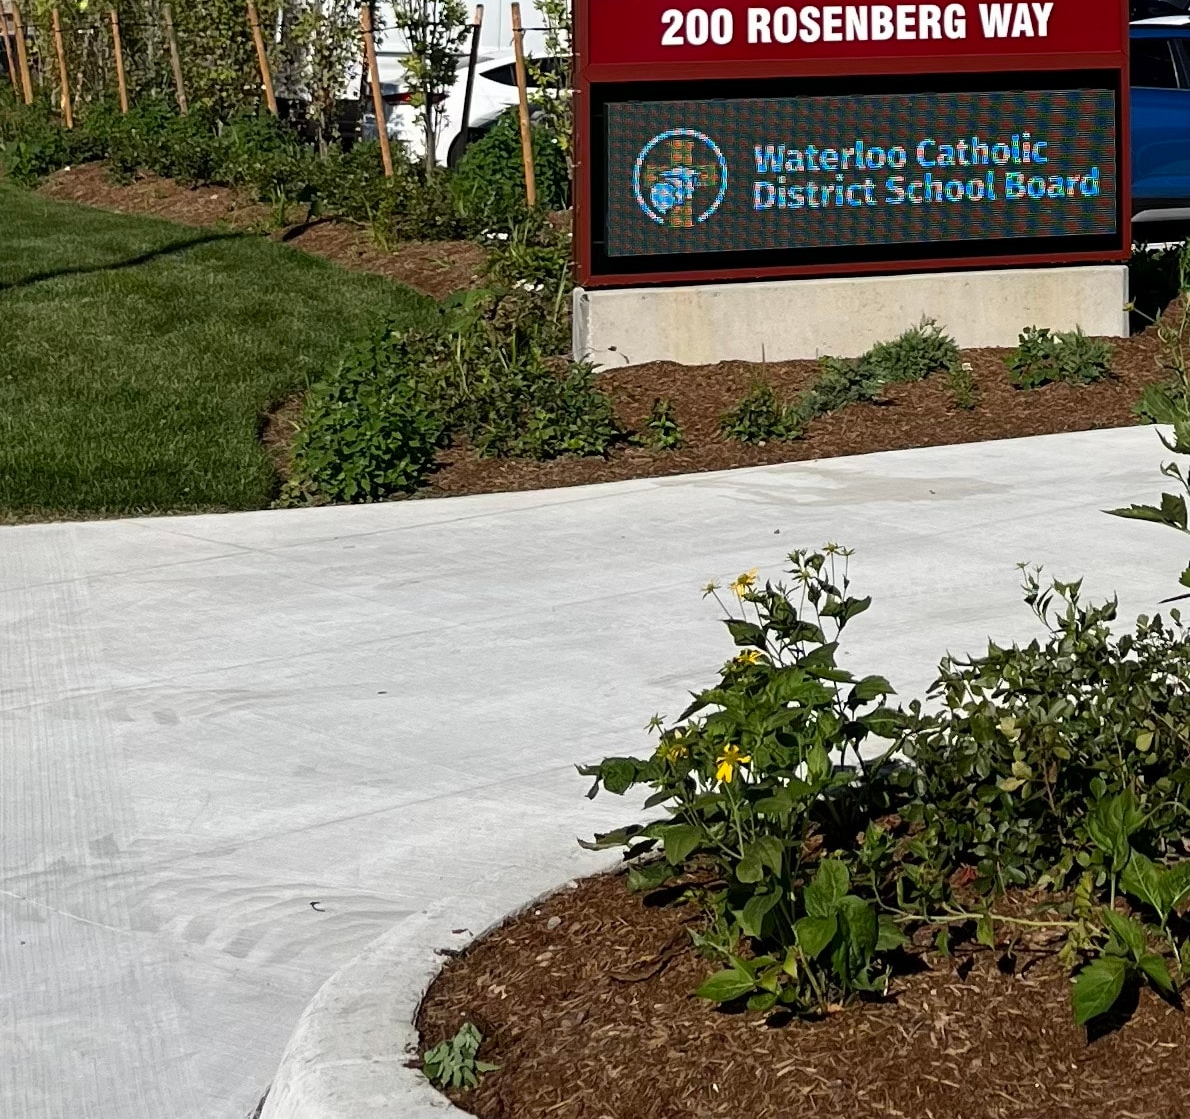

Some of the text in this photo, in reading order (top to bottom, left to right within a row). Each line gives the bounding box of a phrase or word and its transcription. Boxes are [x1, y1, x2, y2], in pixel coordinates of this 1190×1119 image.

[661, 2, 1055, 46] 200 ROSENBERG WAY
[753, 131, 1048, 173] Waterloo Catholic
[752, 166, 1101, 209] District School Board
